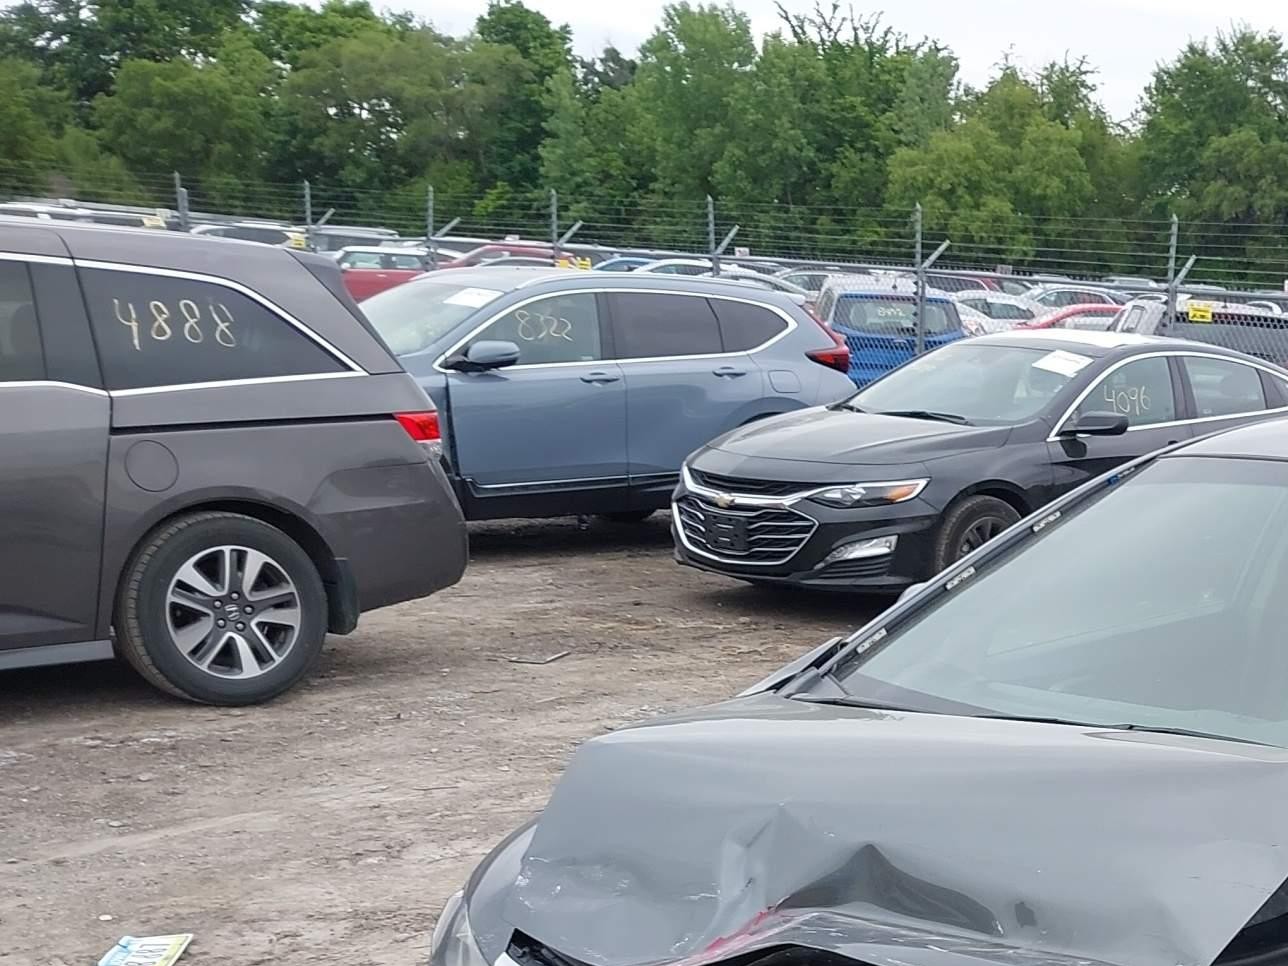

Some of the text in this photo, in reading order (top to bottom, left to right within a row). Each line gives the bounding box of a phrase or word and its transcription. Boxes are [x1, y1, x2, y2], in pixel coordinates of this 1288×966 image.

[113, 298, 237, 350] 4888
[515, 310, 573, 341] 8322
[1103, 384, 1151, 415] 4096
